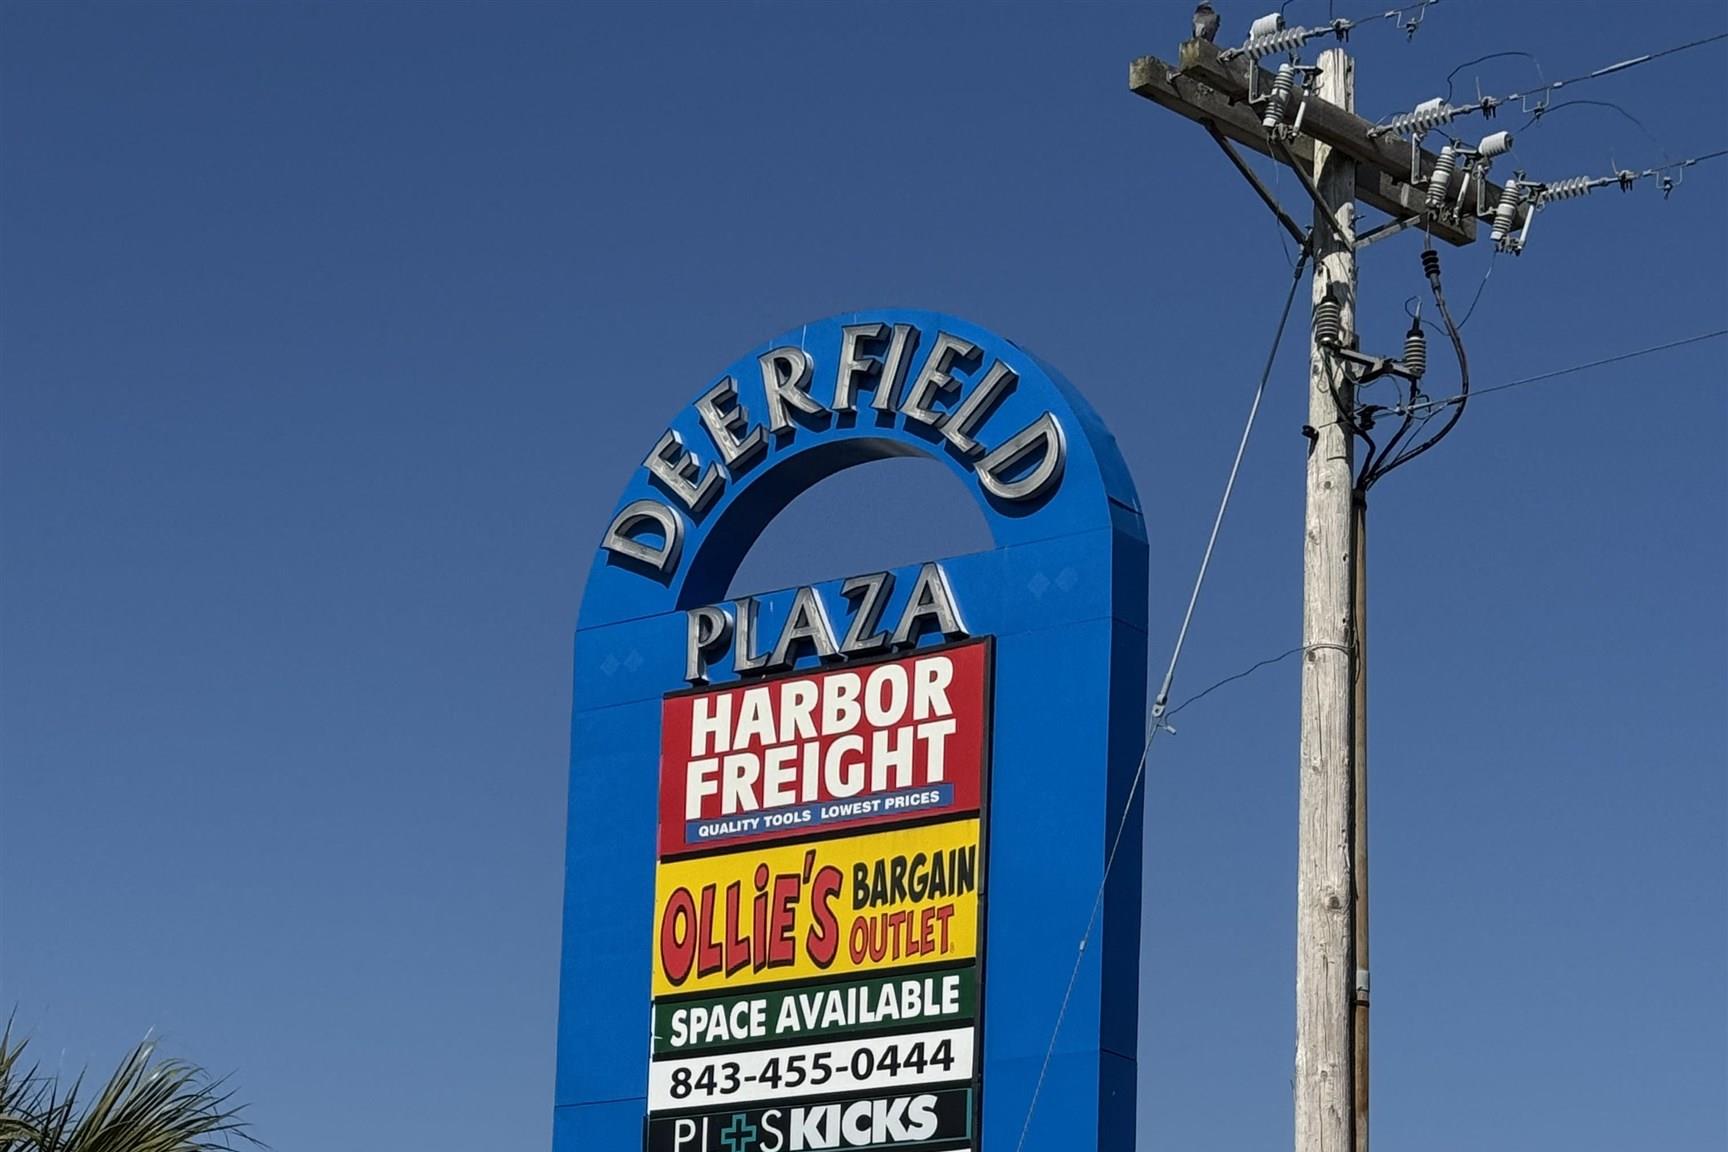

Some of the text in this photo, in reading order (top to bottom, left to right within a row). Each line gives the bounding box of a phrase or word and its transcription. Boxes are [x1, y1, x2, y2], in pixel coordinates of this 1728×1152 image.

[600, 322, 1068, 570] DEERFIELD
[684, 562, 970, 687] PLAZA
[690, 656, 954, 757] HARBOR
[685, 718, 957, 820] FREIGHT
[698, 790, 940, 838] QUALITY TOOLS LOWEST PRICES
[851, 844, 977, 911] BARGAIN
[849, 903, 955, 965] OUTLET
[669, 975, 961, 1048] SPACE AVAILABLE
[669, 1038, 956, 1100] 843-455-0444
